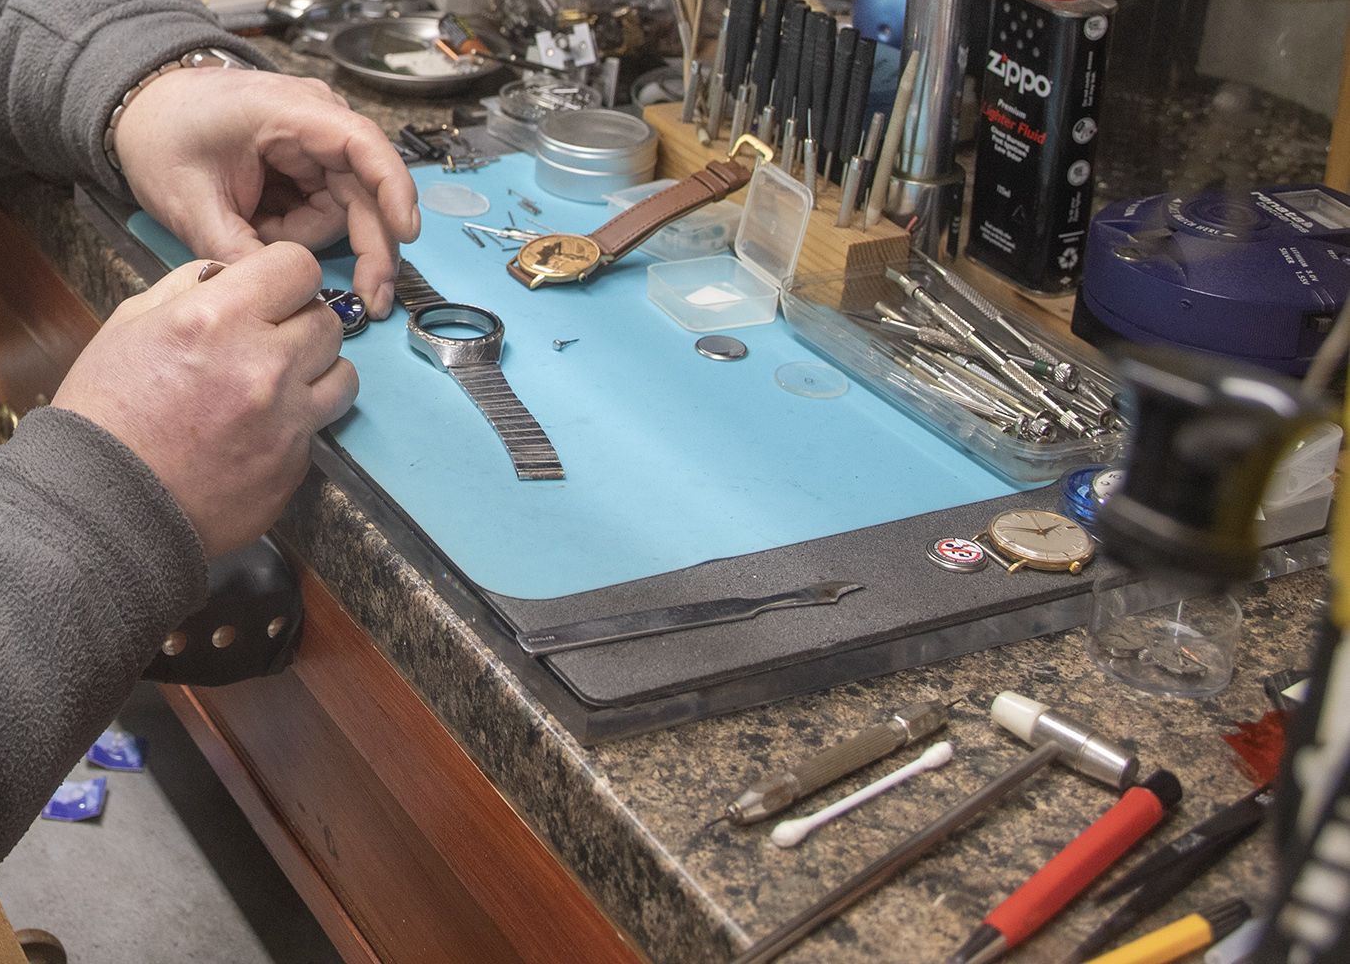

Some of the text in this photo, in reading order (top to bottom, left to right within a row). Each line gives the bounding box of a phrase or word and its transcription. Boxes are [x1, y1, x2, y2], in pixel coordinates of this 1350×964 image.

[997, 98, 1027, 119] Premium
[1017, 122, 1048, 146] Fluid
[1279, 247, 1311, 286] SILVER 1.55V
